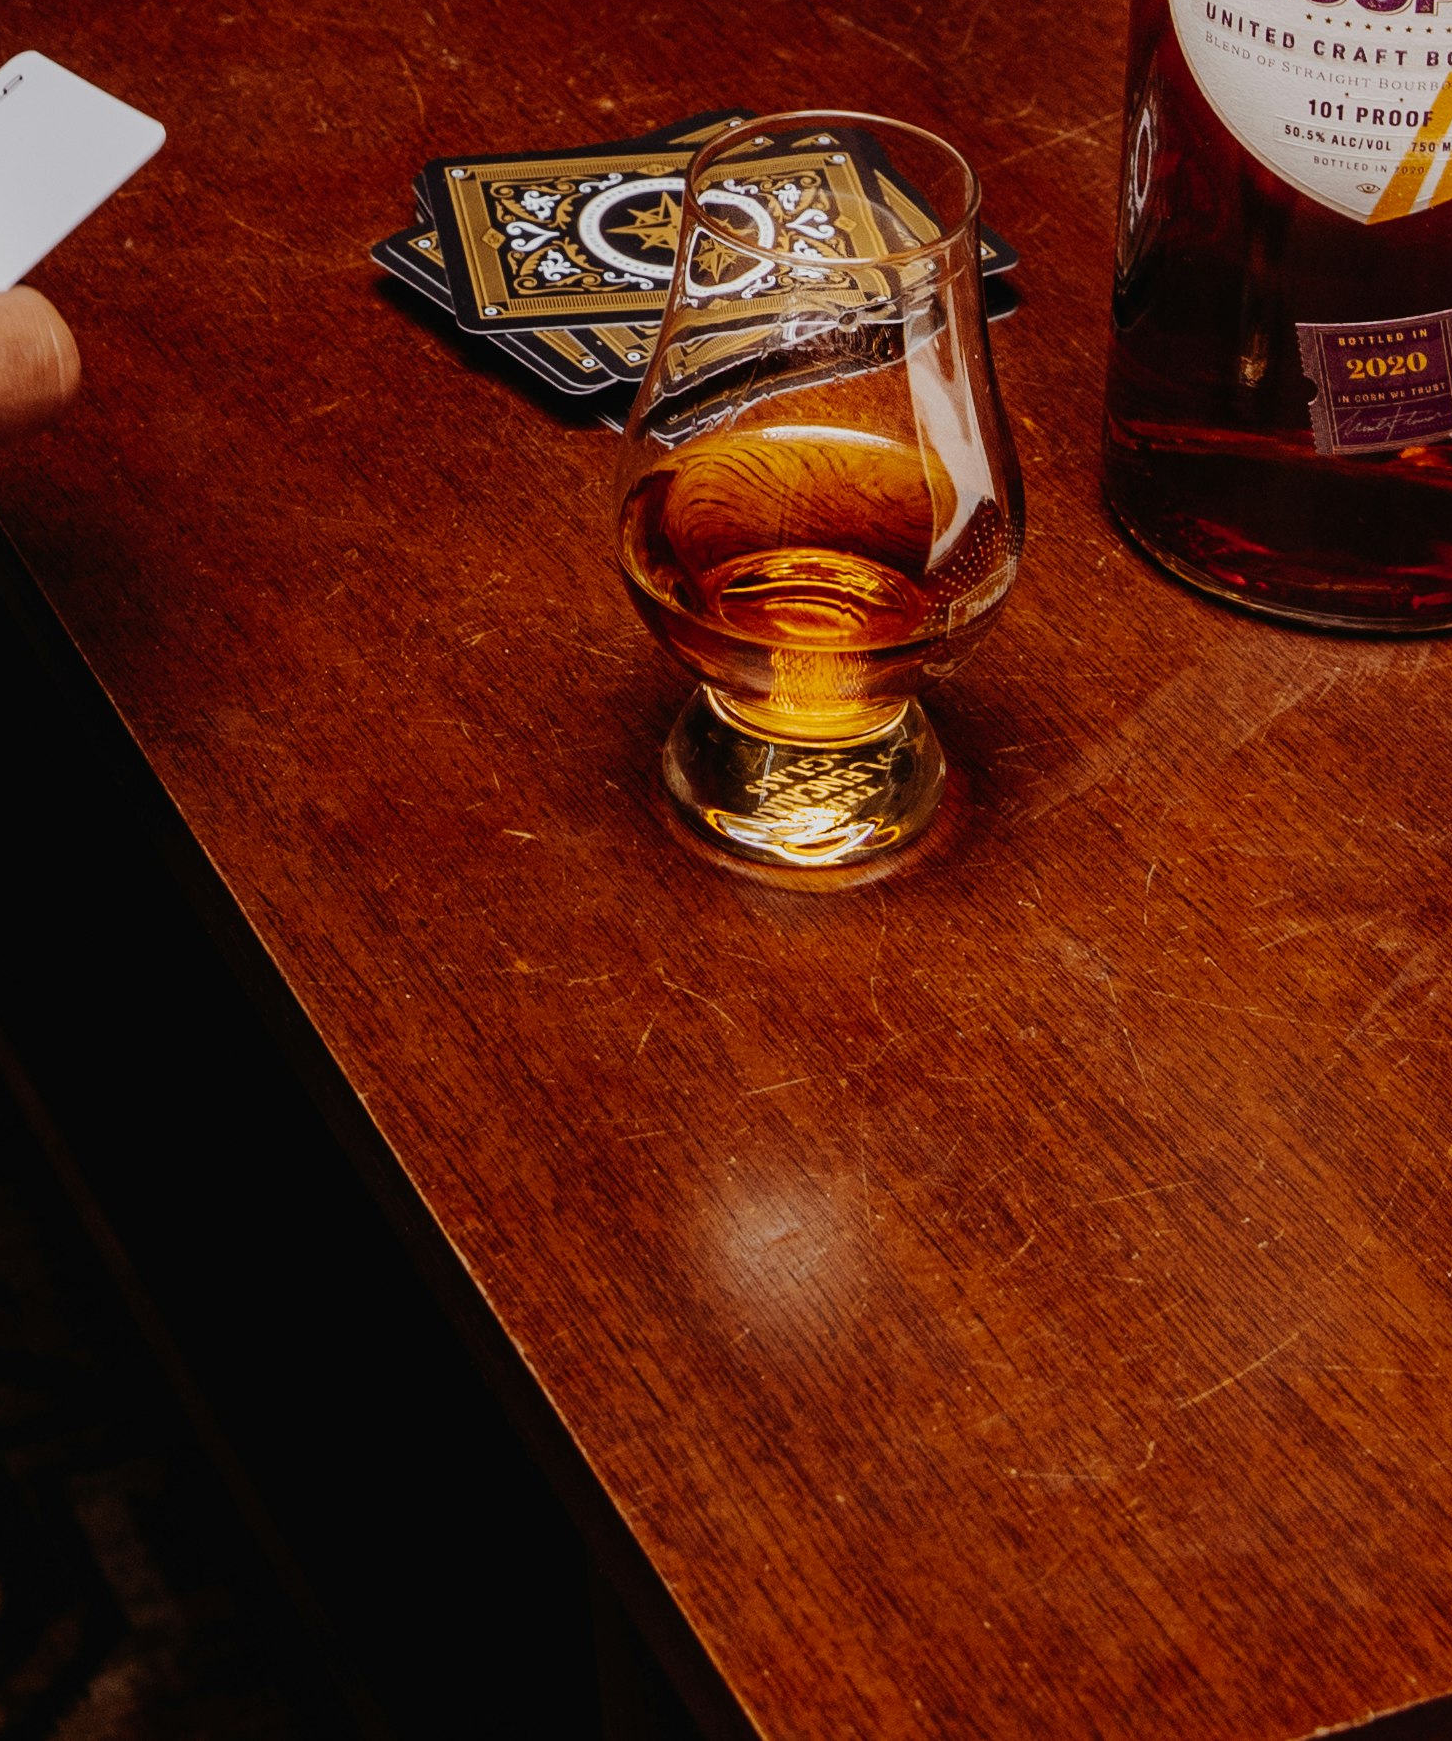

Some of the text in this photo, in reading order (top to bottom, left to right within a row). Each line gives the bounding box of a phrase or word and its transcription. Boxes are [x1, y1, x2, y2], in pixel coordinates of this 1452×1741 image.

[1205, 1, 1296, 49] UNITED
[1313, 39, 1408, 66] CRAFT
[1205, 31, 1251, 59] BLEND
[1256, 54, 1276, 68] OF
[1281, 61, 1372, 89] STRAIGHT
[1308, 99, 1434, 128] 101 PROOF
[1284, 124, 1326, 144] 50.5%
[1331, 134, 1392, 152] ALC/VOL
[1411, 142, 1437, 153] 750
[1313, 156, 1369, 172] BOTTLED
[1375, 165, 1388, 174] IN
[1338, 328, 1429, 347] BOTTLED IN
[1346, 351, 1428, 380] 2020
[1337, 395, 1350, 403] IN
[1354, 393, 1386, 403] CORN
[1410, 382, 1447, 396] TRUST
